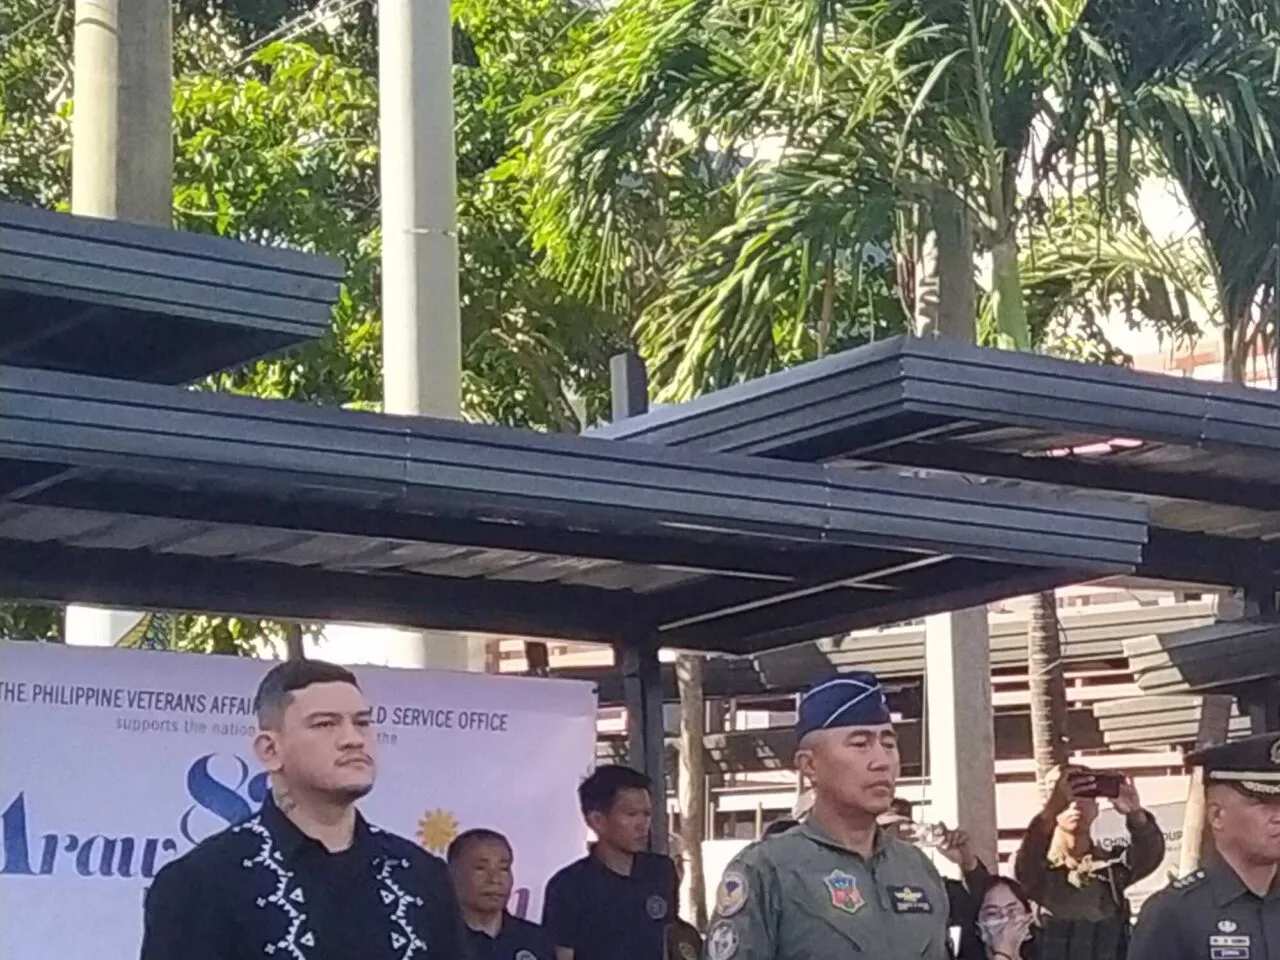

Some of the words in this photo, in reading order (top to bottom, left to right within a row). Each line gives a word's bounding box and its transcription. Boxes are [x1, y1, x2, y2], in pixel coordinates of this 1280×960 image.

[0, 682, 27, 702] THE
[32, 684, 125, 709] PHILIPPINE
[127, 690, 207, 713] VETERANS
[392, 707, 453, 729] SERVICE
[458, 711, 509, 732] OFFICE
[115, 716, 179, 733] supports
[184, 719, 207, 733] the
